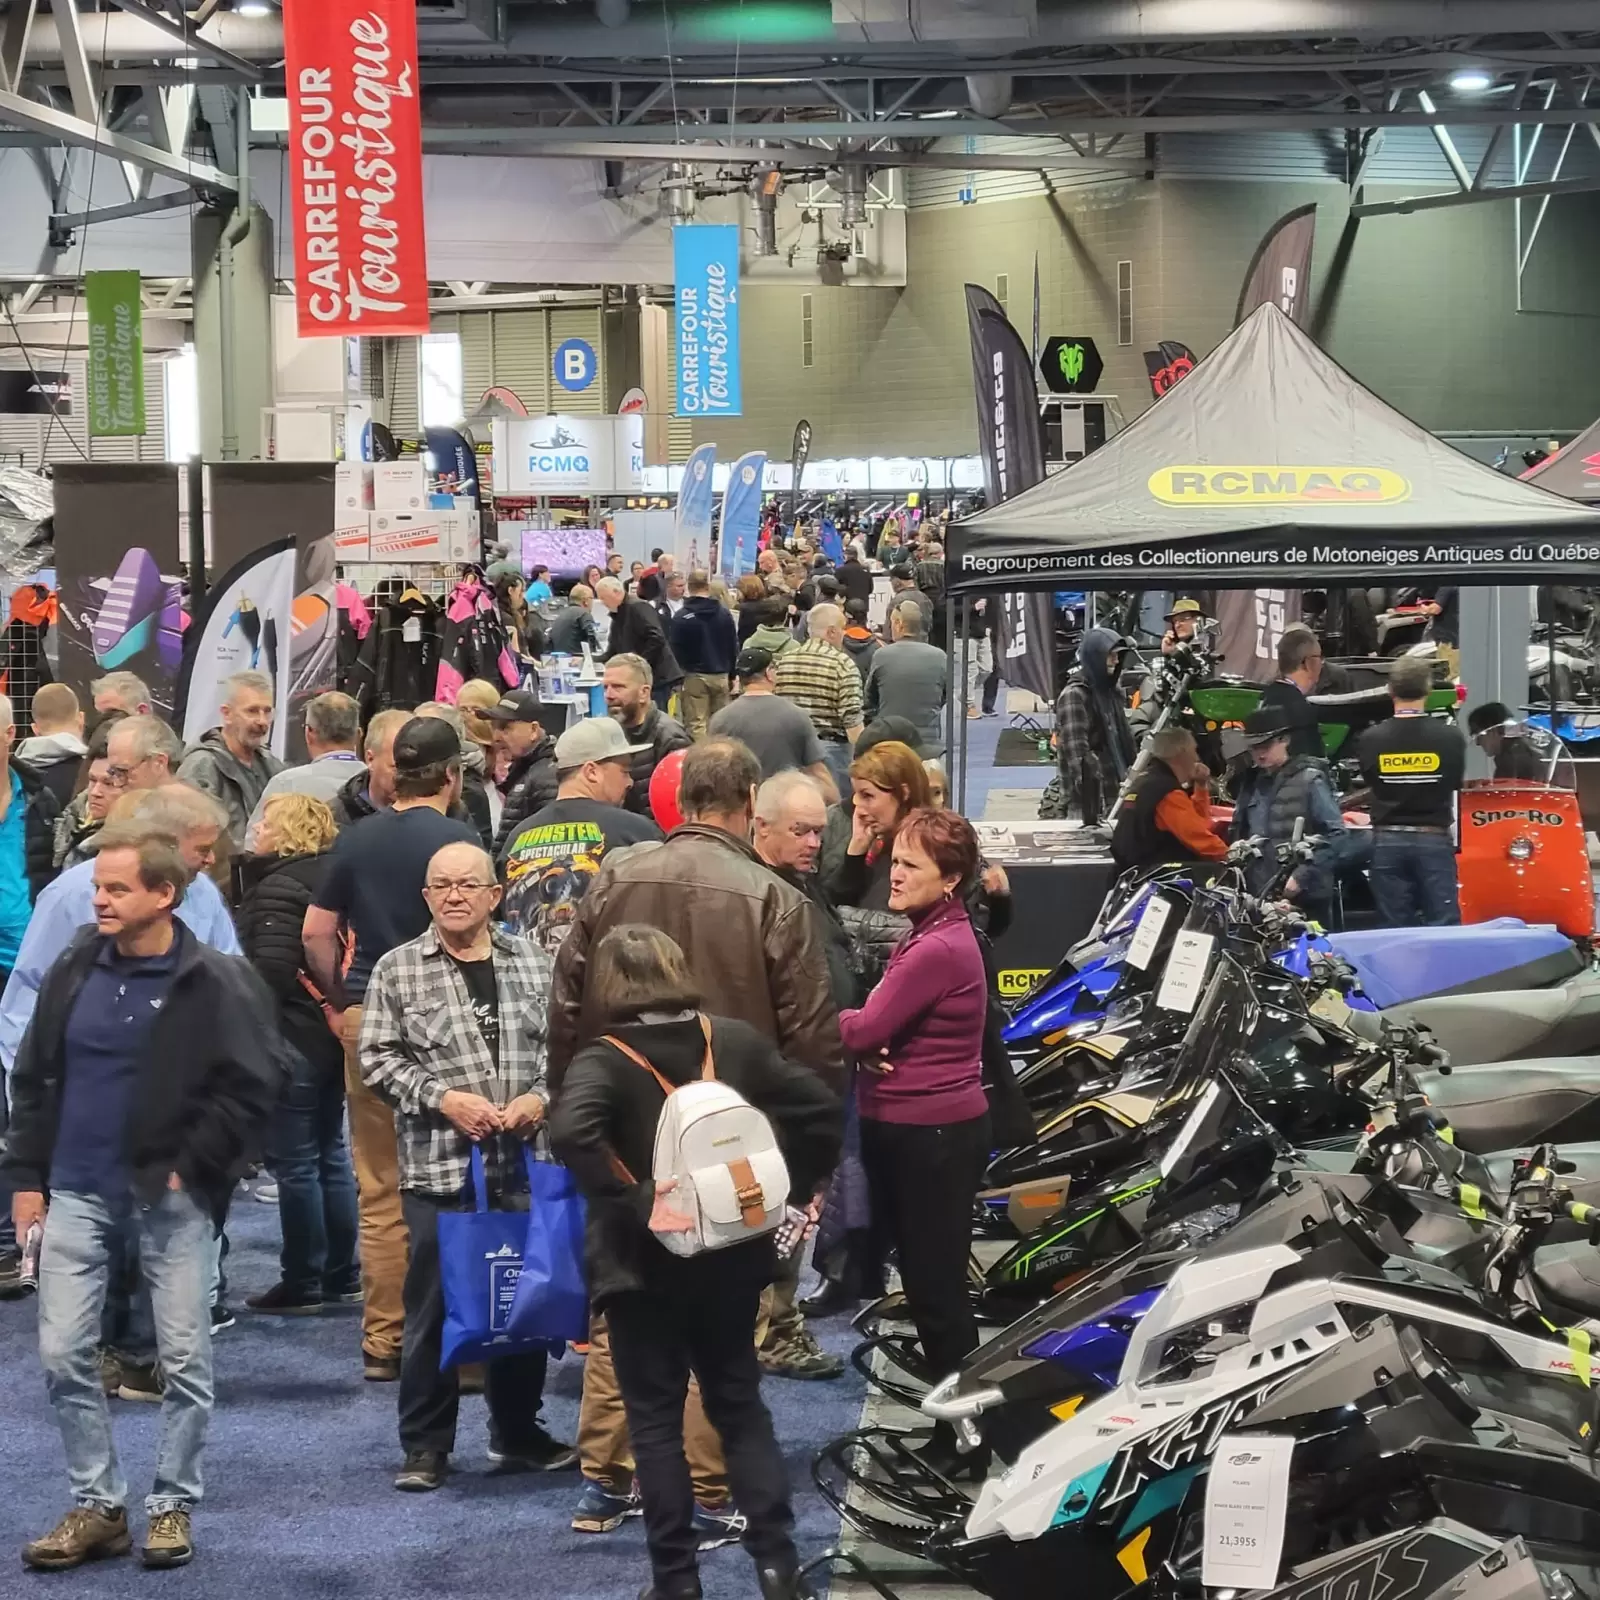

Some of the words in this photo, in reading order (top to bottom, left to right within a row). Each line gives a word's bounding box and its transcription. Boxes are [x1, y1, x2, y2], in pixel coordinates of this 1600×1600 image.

[339, 10, 414, 322] Touristique
[299, 66, 343, 322] CARREFOUR
[681, 287, 699, 412] CARREFOUR
[700, 261, 737, 412] Touristique
[92, 323, 110, 430] CARREFOUR
[110, 301, 141, 430] Touristique
[564, 349, 586, 380] B
[528, 455, 590, 473] FCMQ
[1171, 472, 1384, 498] RCMAQ
[962, 552, 1095, 574] Regroupement
[1100, 550, 1134, 567] des
[1138, 548, 1279, 567] Collectionneurs
[1284, 546, 1308, 563] de
[1312, 545, 1419, 567] Motoneiges
[1423, 544, 1505, 565] Antiques
[1509, 543, 1533, 561] du
[1383, 756, 1433, 768] RCMAQ
[508, 821, 602, 856] MONSTER
[519, 842, 587, 861] SPECTACULAR
[1219, 1535, 1257, 1547] 21,395$
